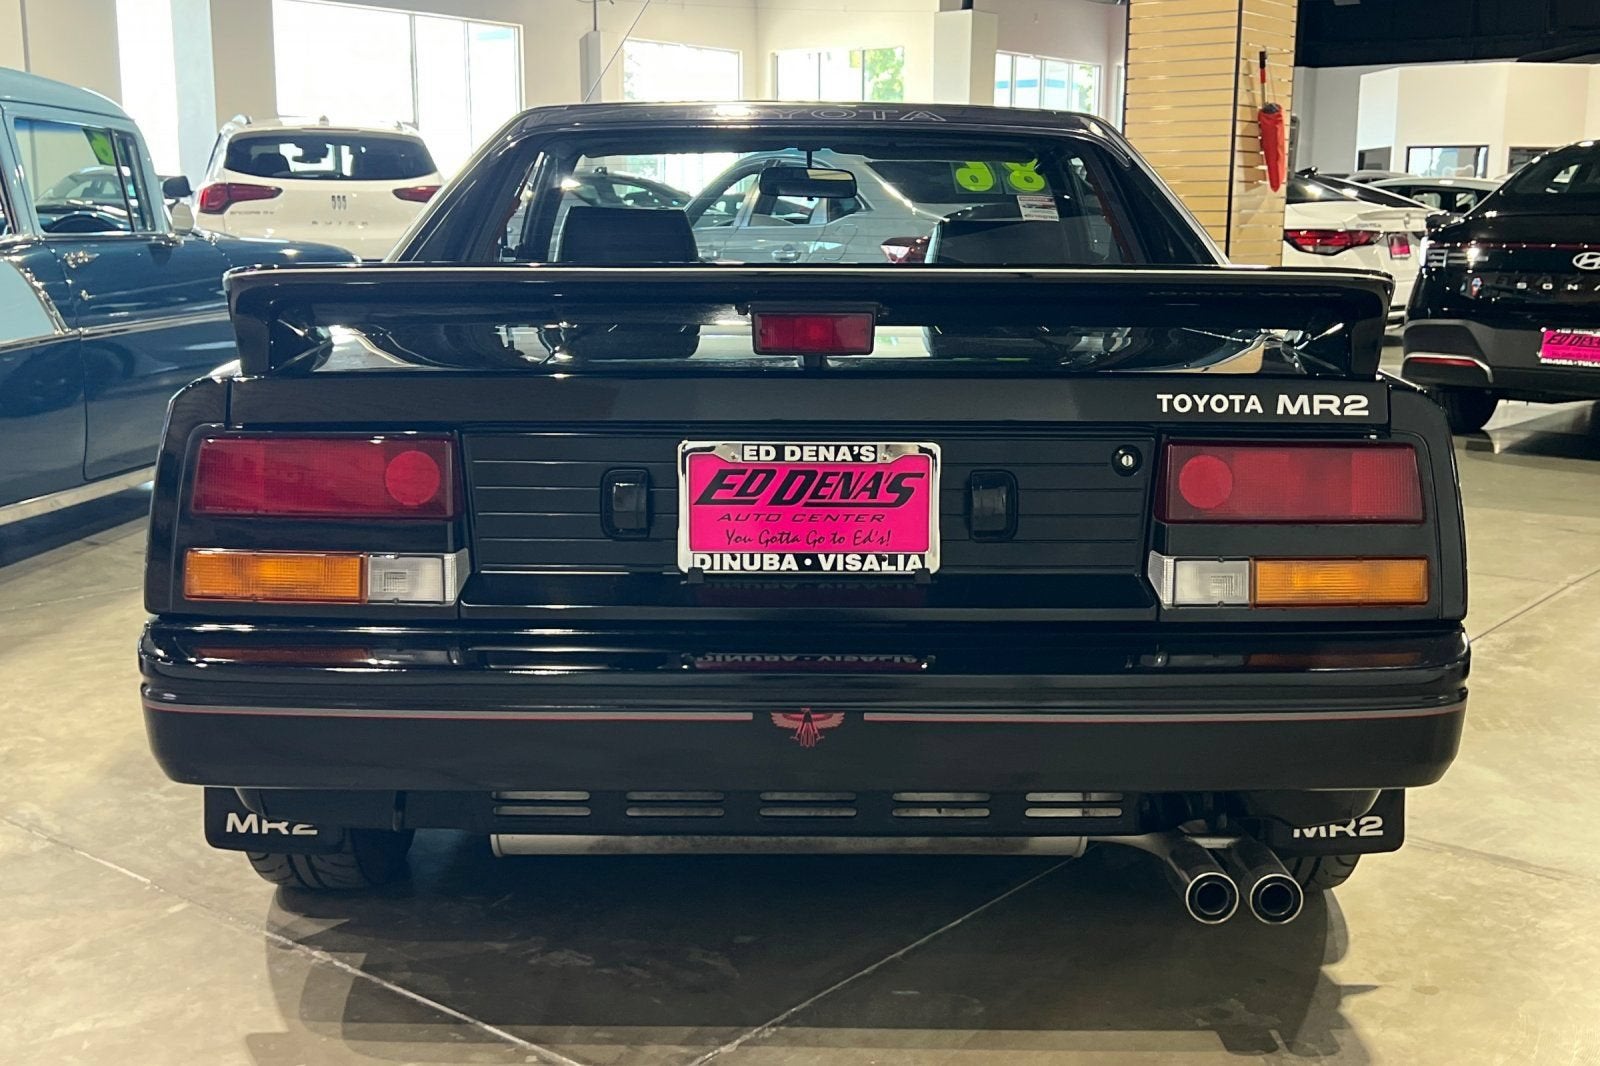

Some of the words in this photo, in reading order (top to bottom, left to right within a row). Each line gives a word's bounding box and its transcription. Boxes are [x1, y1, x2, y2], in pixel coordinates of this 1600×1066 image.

[1156, 393, 1263, 414] TOYOTA
[1276, 394, 1369, 416] MR2
[743, 445, 777, 462] ED
[784, 445, 876, 462] DENA'S
[693, 468, 777, 506] ED
[767, 469, 926, 508] DENA'S
[716, 513, 782, 523] AUTO
[791, 513, 886, 523] CENTER
[726, 529, 752, 545] You
[758, 529, 801, 547] Gotta
[806, 529, 825, 546] Go
[830, 531, 846, 545] to
[852, 529, 892, 546] Ed's!
[694, 553, 799, 571] DINUBA
[817, 553, 923, 572] VISALIA
